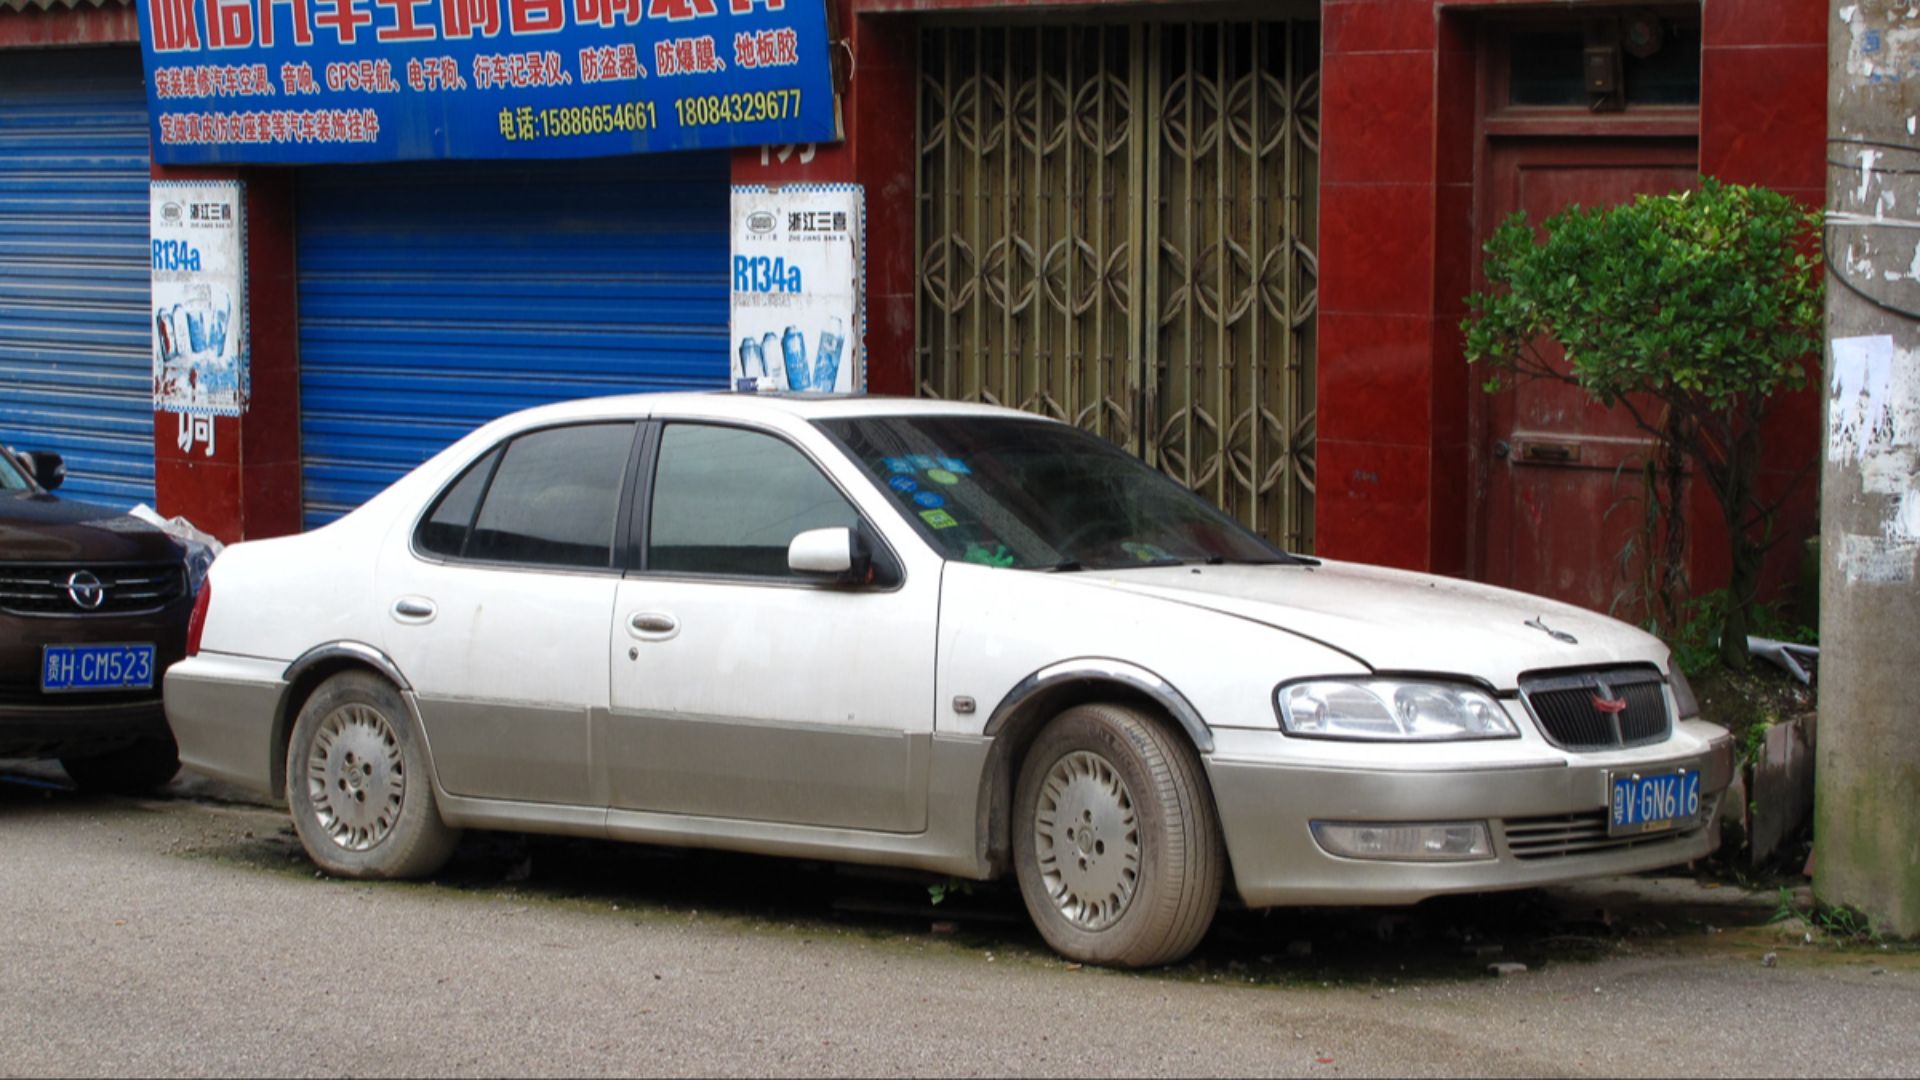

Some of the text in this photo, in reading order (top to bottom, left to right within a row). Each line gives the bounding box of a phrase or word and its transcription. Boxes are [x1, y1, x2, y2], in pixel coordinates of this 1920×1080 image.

[499, 88, 802, 141] 电话:15886654661 18084329677
[152, 238, 200, 271] R134a
[734, 254, 802, 293] R134a
